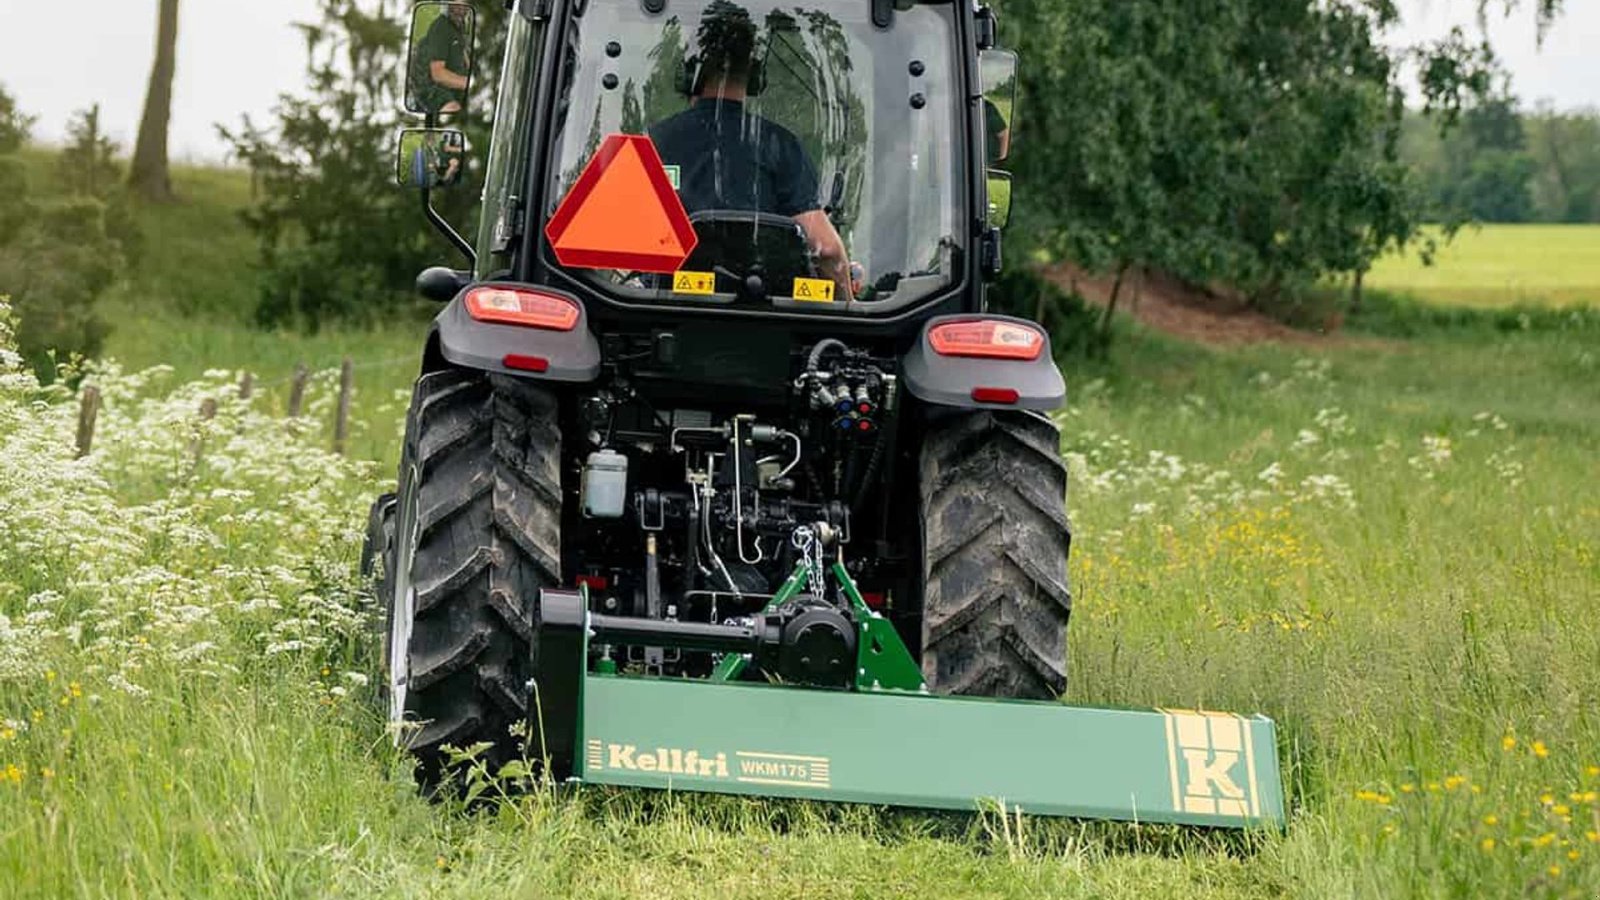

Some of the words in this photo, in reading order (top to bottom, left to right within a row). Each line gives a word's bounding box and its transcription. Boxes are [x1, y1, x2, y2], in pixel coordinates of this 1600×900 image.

[608, 744, 729, 777] Kellfri
[740, 760, 807, 779] WKM175
[1182, 748, 1245, 800] K
